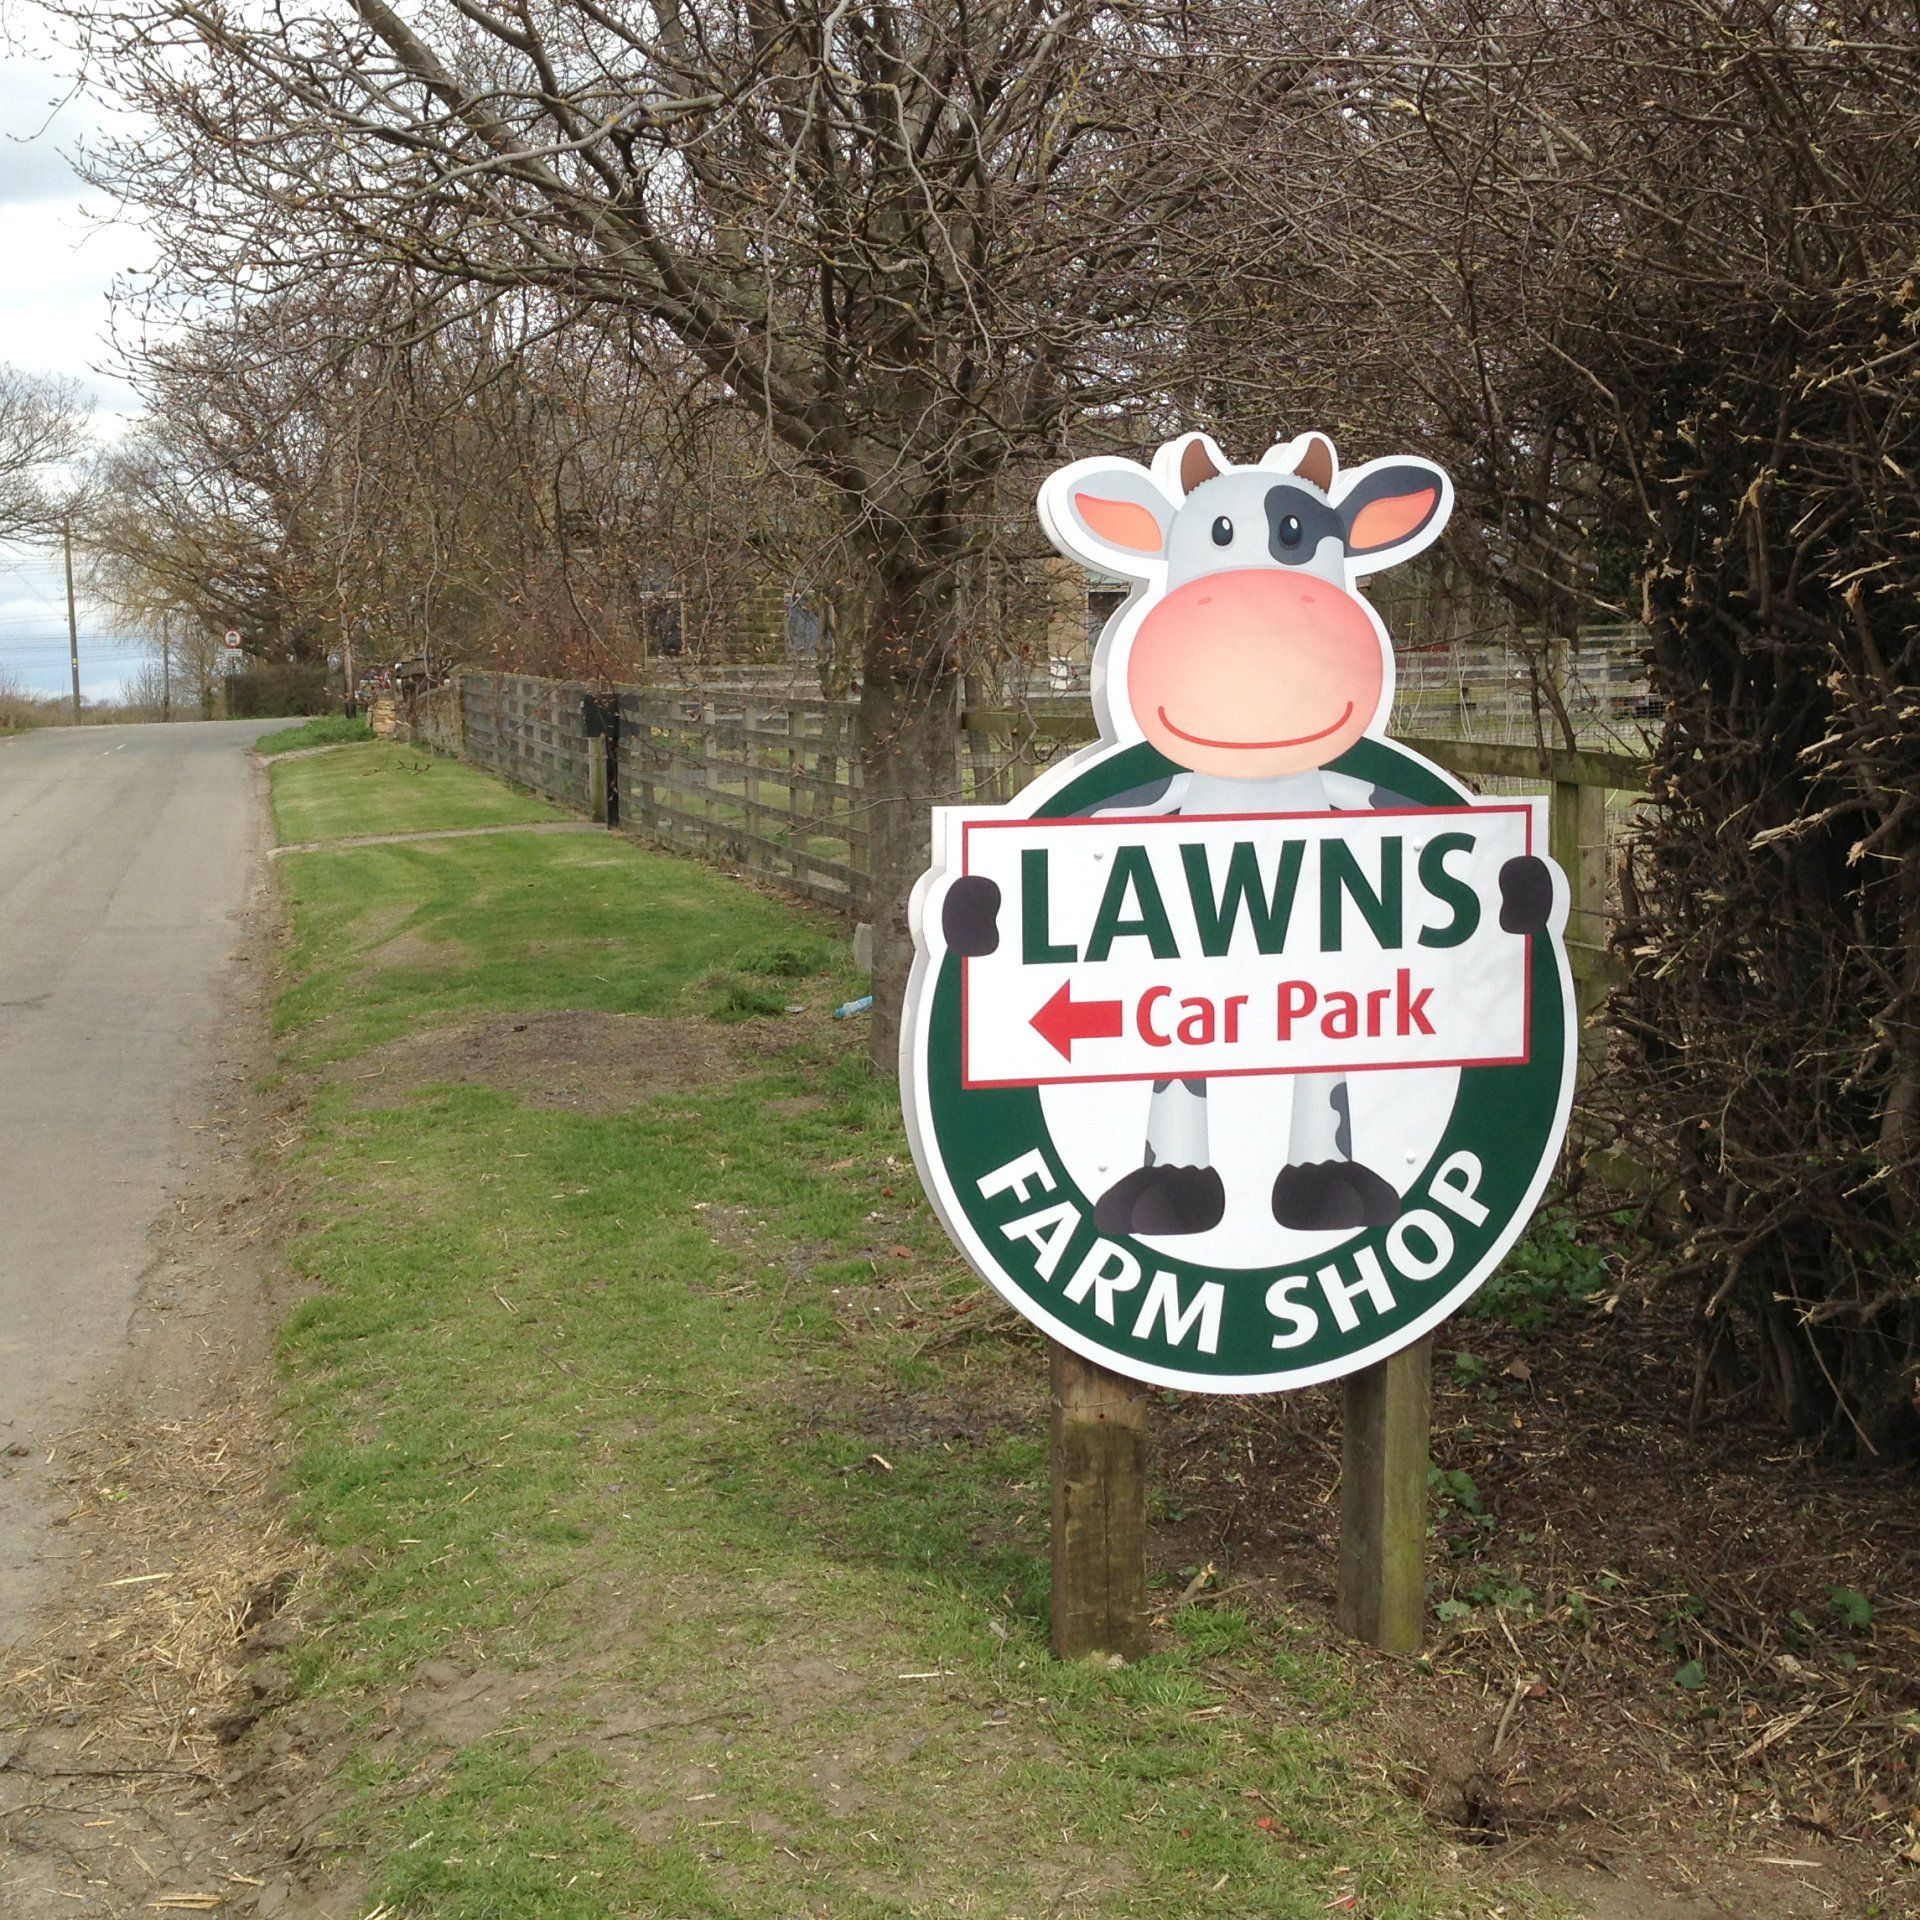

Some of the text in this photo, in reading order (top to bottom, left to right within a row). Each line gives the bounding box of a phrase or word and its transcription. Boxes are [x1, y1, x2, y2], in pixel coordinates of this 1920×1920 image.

[1020, 832, 1482, 965] LAWNS
[1135, 967, 1437, 1047] Car Park
[976, 1147, 1492, 1355] FARM SHOP
